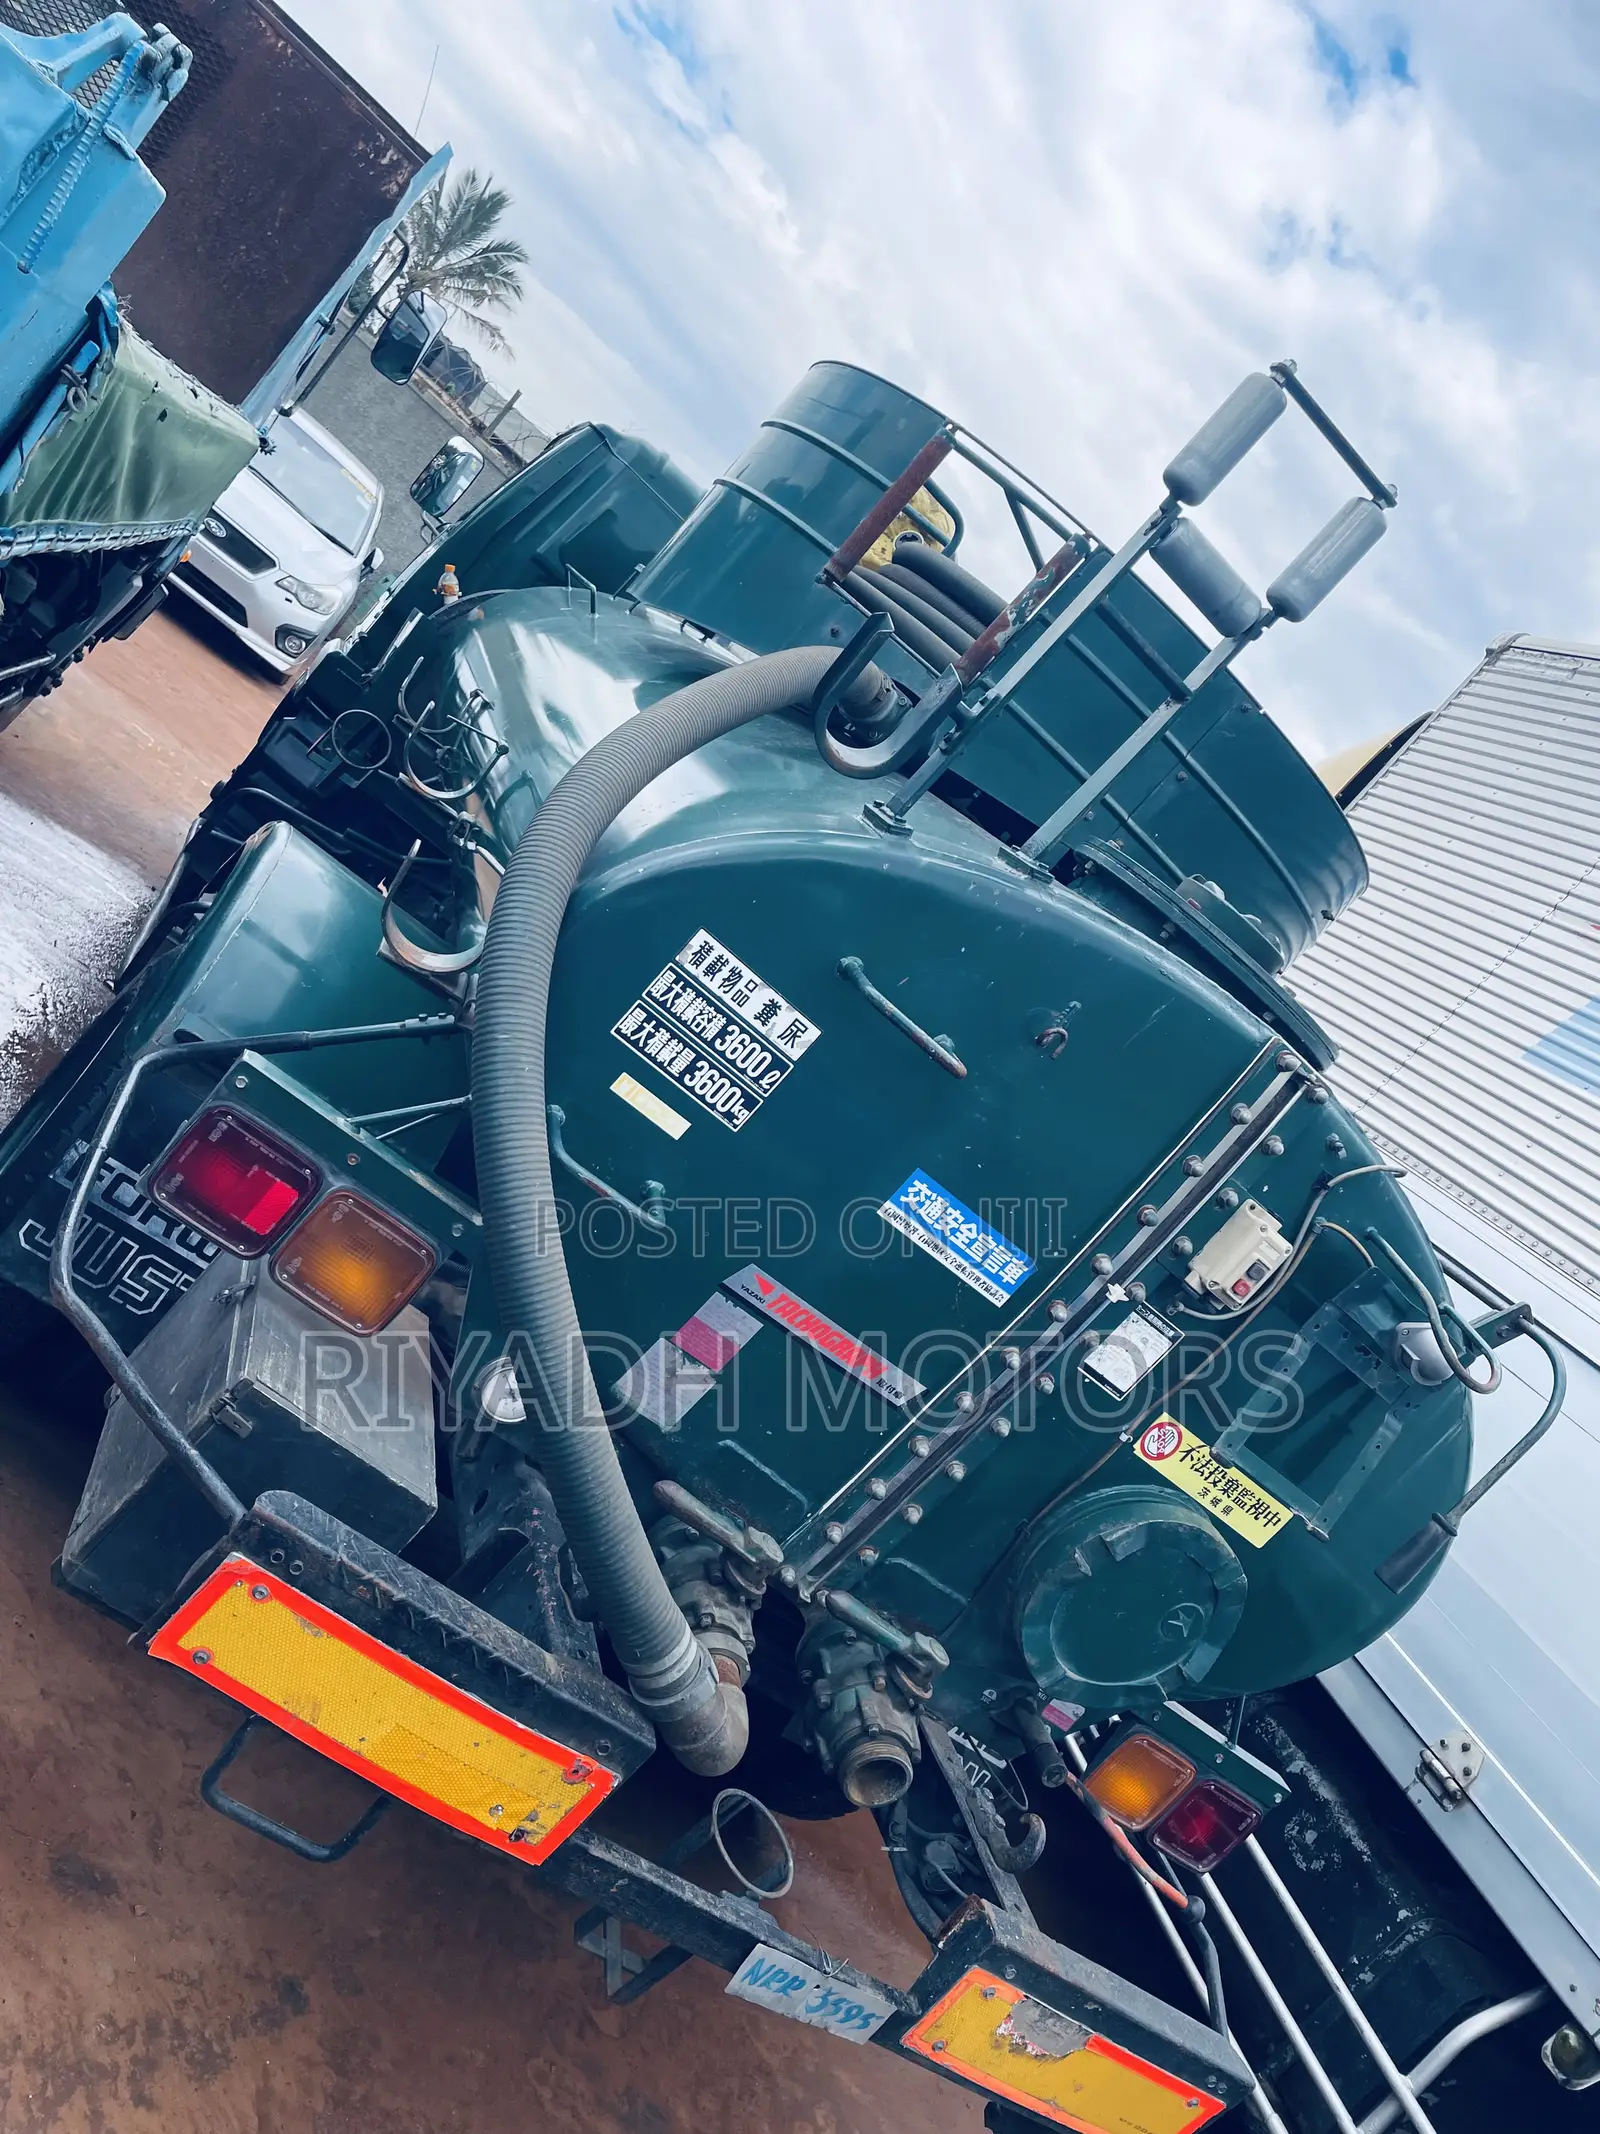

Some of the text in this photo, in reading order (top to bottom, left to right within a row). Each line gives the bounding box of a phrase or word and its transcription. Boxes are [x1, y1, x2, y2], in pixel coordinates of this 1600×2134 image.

[685, 939, 759, 1008] 積載物品
[617, 1006, 695, 1077] 最大積載量
[648, 969, 727, 1042] 最大積載容積
[713, 1024, 772, 1078] 3600
[899, 1178, 1029, 1285] 交通安全宣言車
[741, 1283, 765, 1304] YAZAKI
[1178, 1443, 1281, 1527] 不法投棄監視中
[1196, 1485, 1233, 1517] 茨城県
